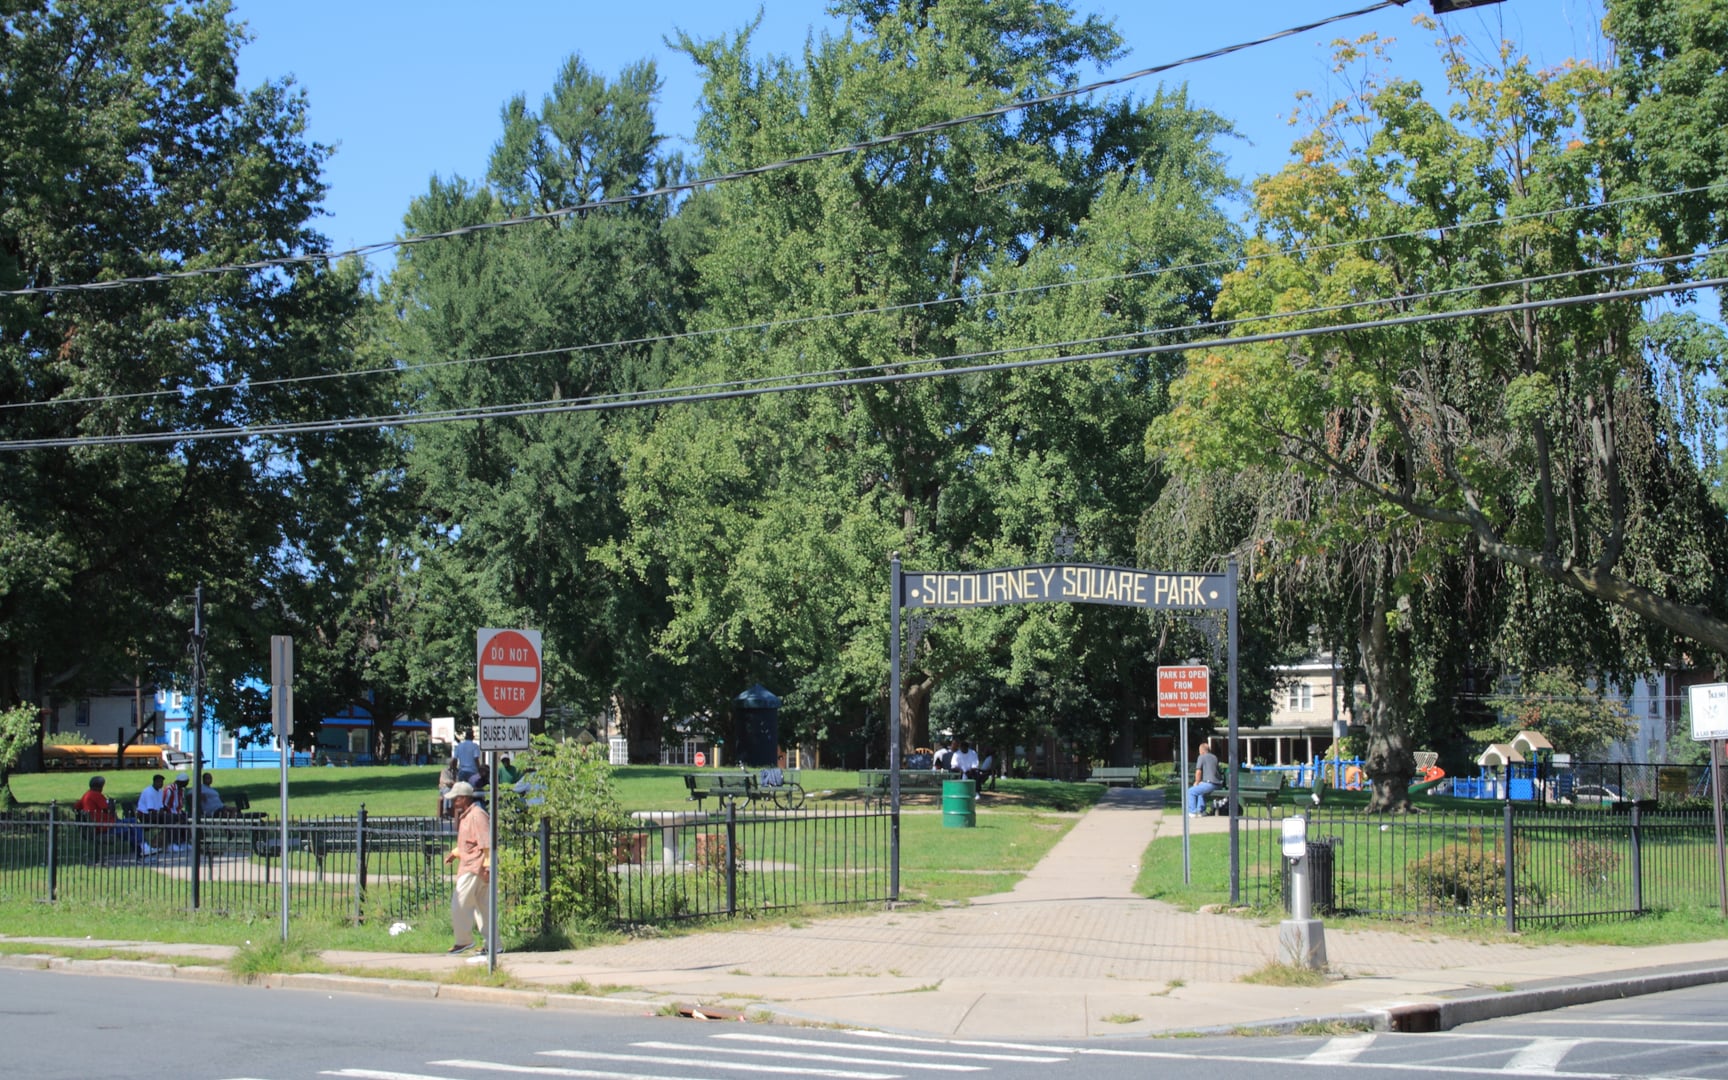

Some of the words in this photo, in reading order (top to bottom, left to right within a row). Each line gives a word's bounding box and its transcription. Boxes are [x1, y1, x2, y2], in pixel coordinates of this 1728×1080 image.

[923, 568, 1056, 604] SIGOURNEY
[1062, 567, 1148, 603] SQUARE
[1154, 576, 1207, 605] PARK
[491, 647, 504, 660] DO
[509, 648, 528, 662] NOT
[1160, 670, 1178, 679] PARK
[1179, 670, 1186, 679] IS
[1188, 670, 1207, 679] OPEN
[1174, 681, 1193, 689] FROM
[494, 687, 525, 700] ENTER
[1160, 691, 1178, 700] DAWN
[1180, 691, 1189, 700] TO
[1190, 691, 1207, 700] DUSK
[483, 726, 506, 741] BUSES
[508, 726, 527, 741] ONLY
